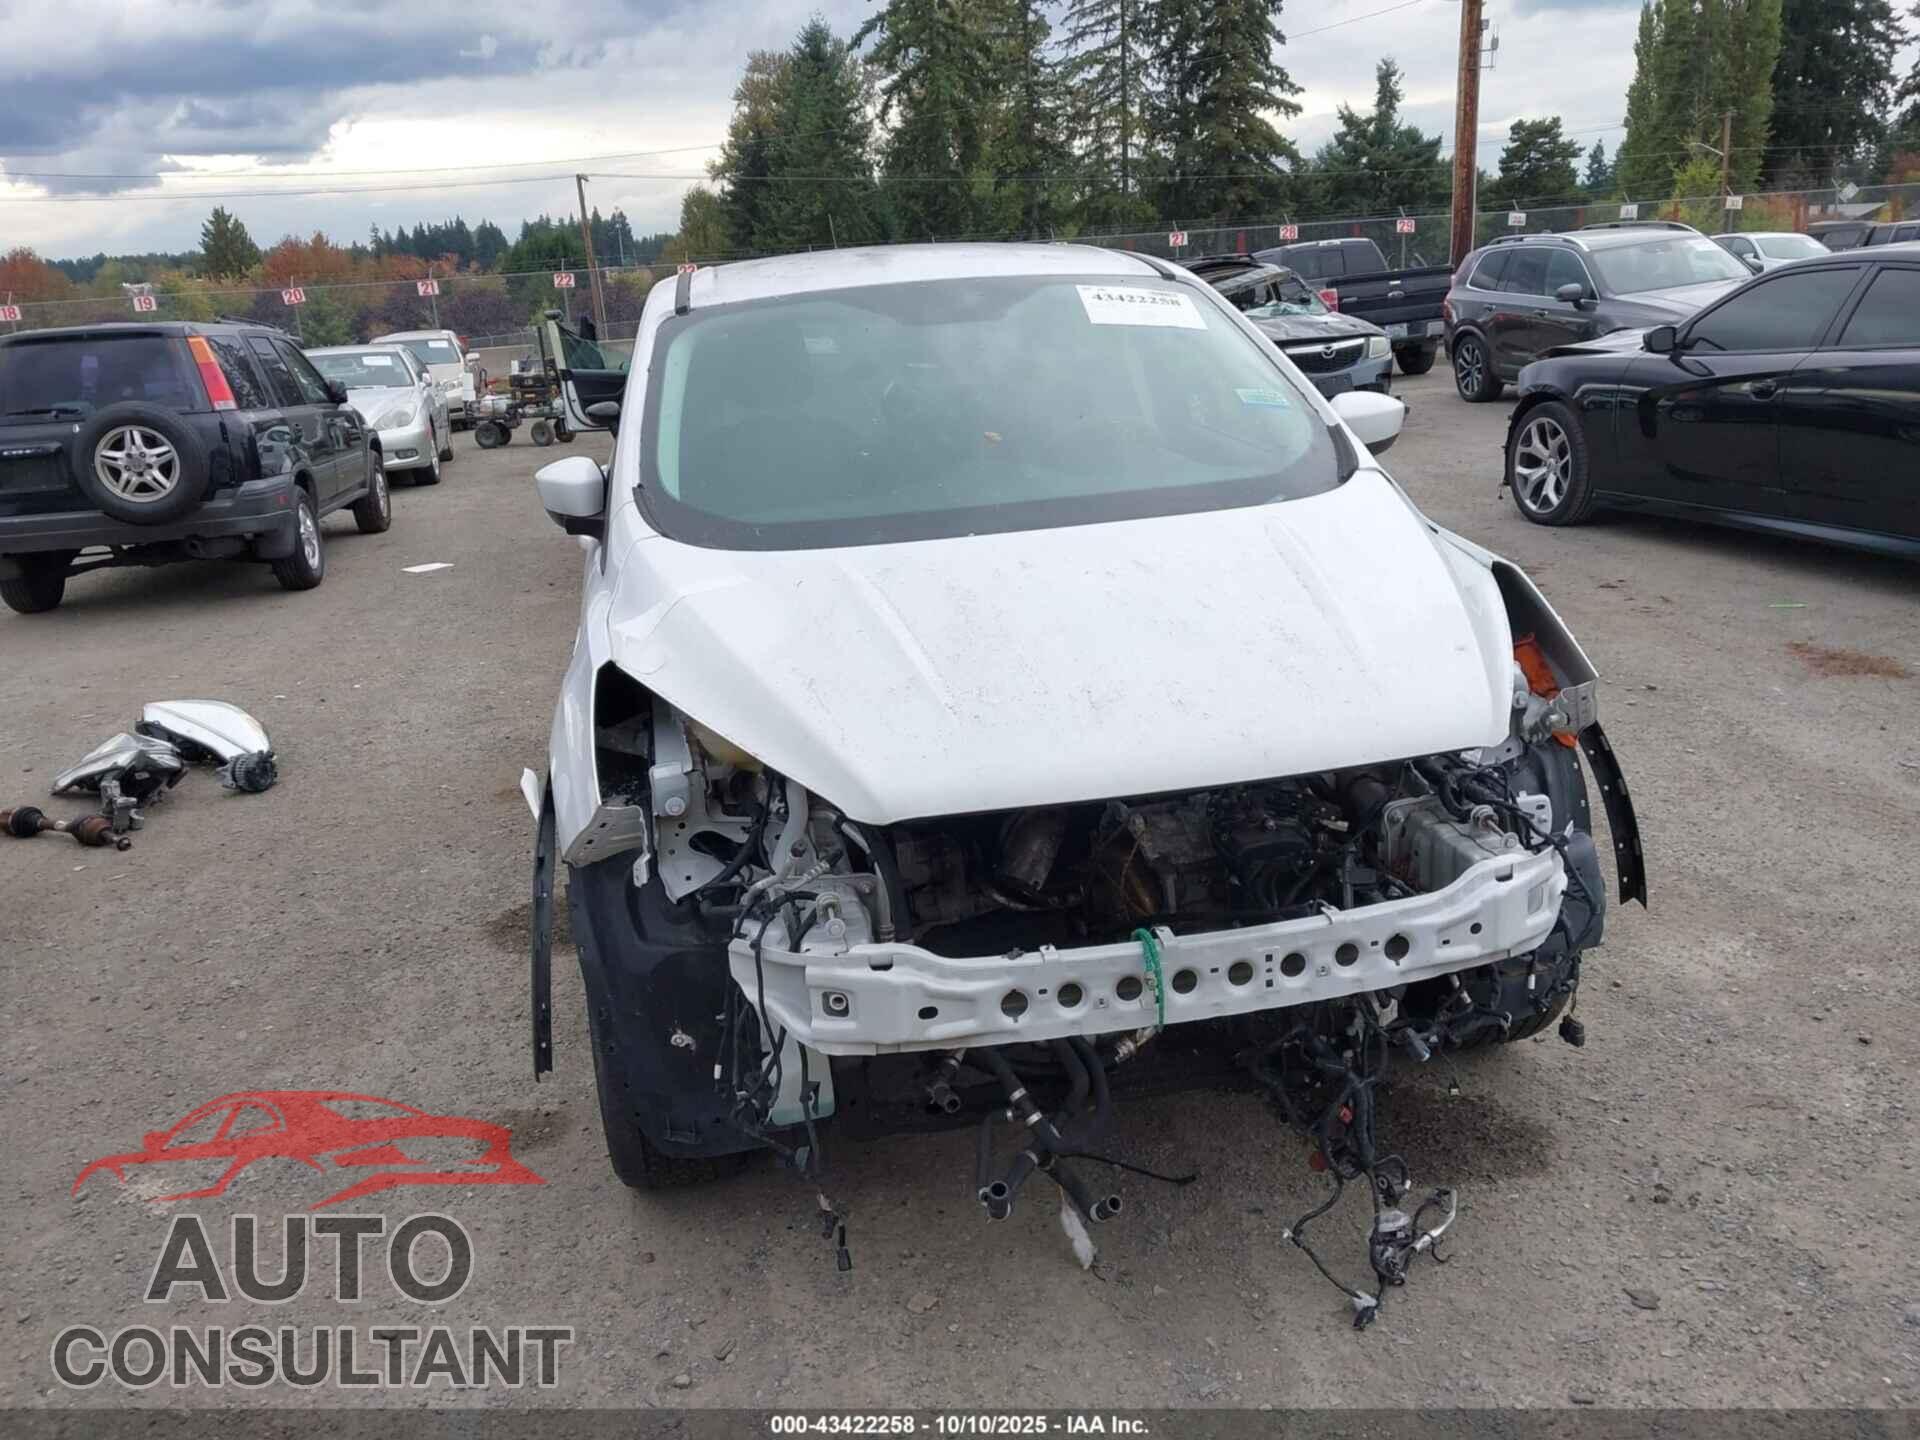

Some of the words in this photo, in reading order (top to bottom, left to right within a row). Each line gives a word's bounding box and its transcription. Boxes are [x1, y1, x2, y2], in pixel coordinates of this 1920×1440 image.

[555, 273, 573, 286] 22
[284, 288, 303, 303] 20
[136, 296, 153, 310] 19
[1, 306, 17, 320] 18
